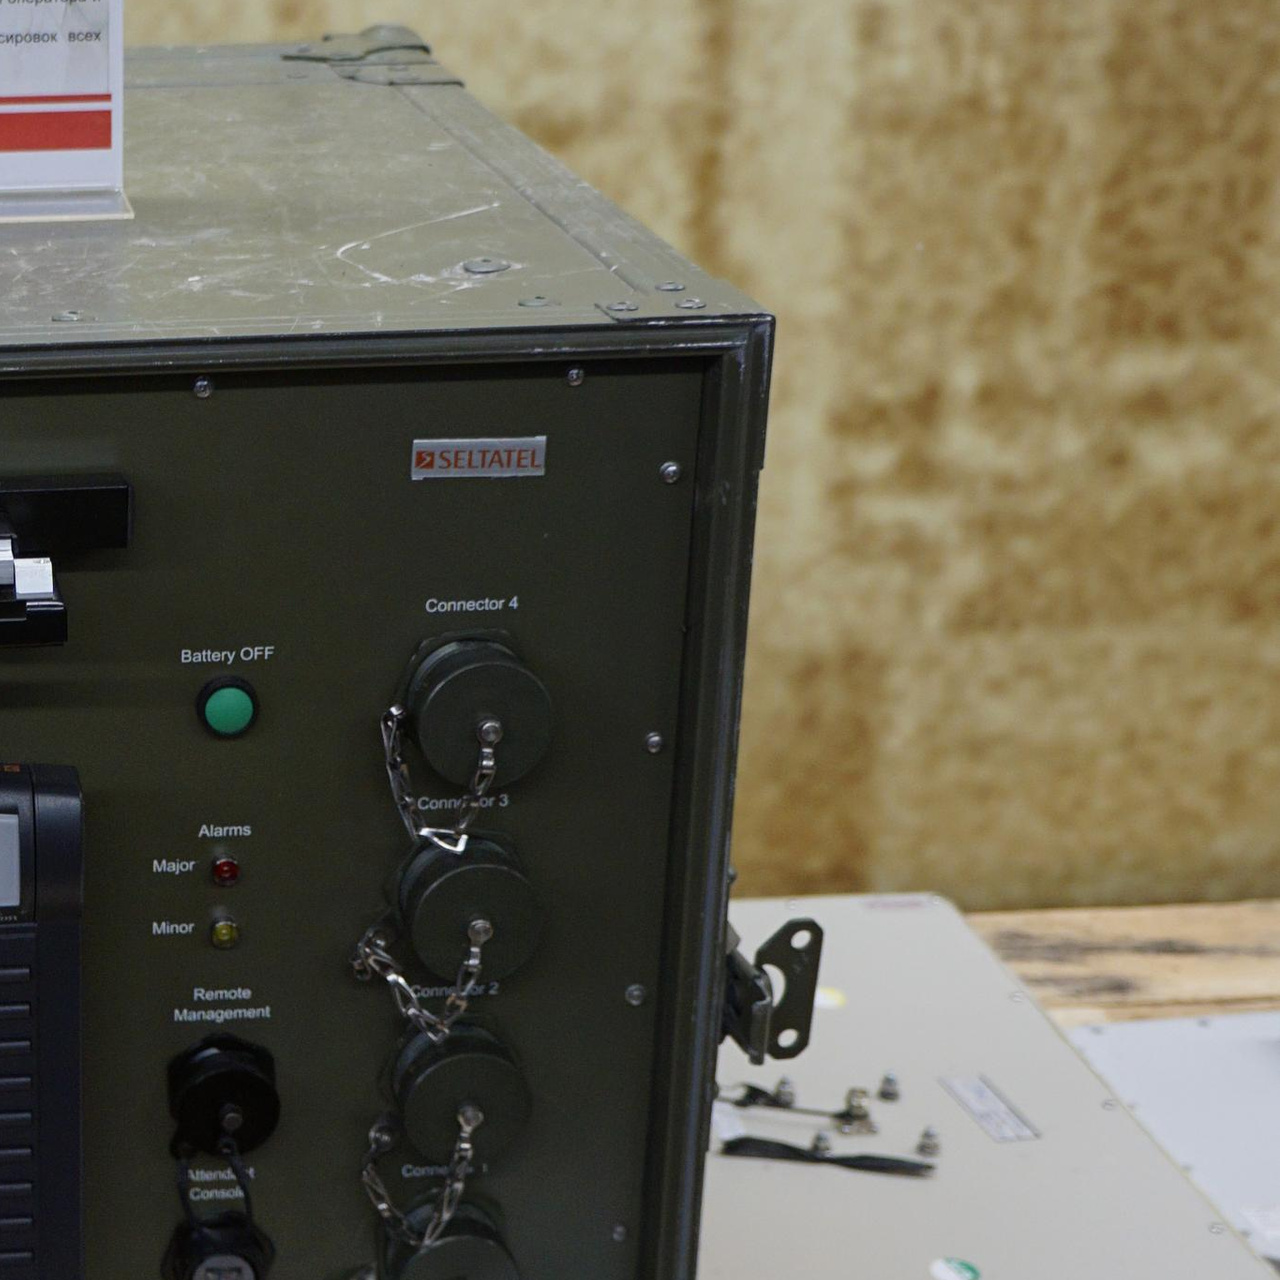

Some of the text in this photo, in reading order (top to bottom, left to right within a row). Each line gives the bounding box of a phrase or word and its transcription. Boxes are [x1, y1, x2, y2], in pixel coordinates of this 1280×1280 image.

[68, 32, 102, 43] всех
[439, 448, 541, 470] SELTATEL
[425, 595, 519, 613] Connector 4
[181, 646, 275, 665] Battery OFF
[417, 794, 509, 810] Connor 3
[198, 824, 252, 838] Alarms
[153, 859, 196, 875] Major
[152, 922, 195, 936] Minor
[193, 987, 252, 1001] Remote
[411, 981, 500, 998] Conneor 2
[174, 1005, 271, 1023] Management
